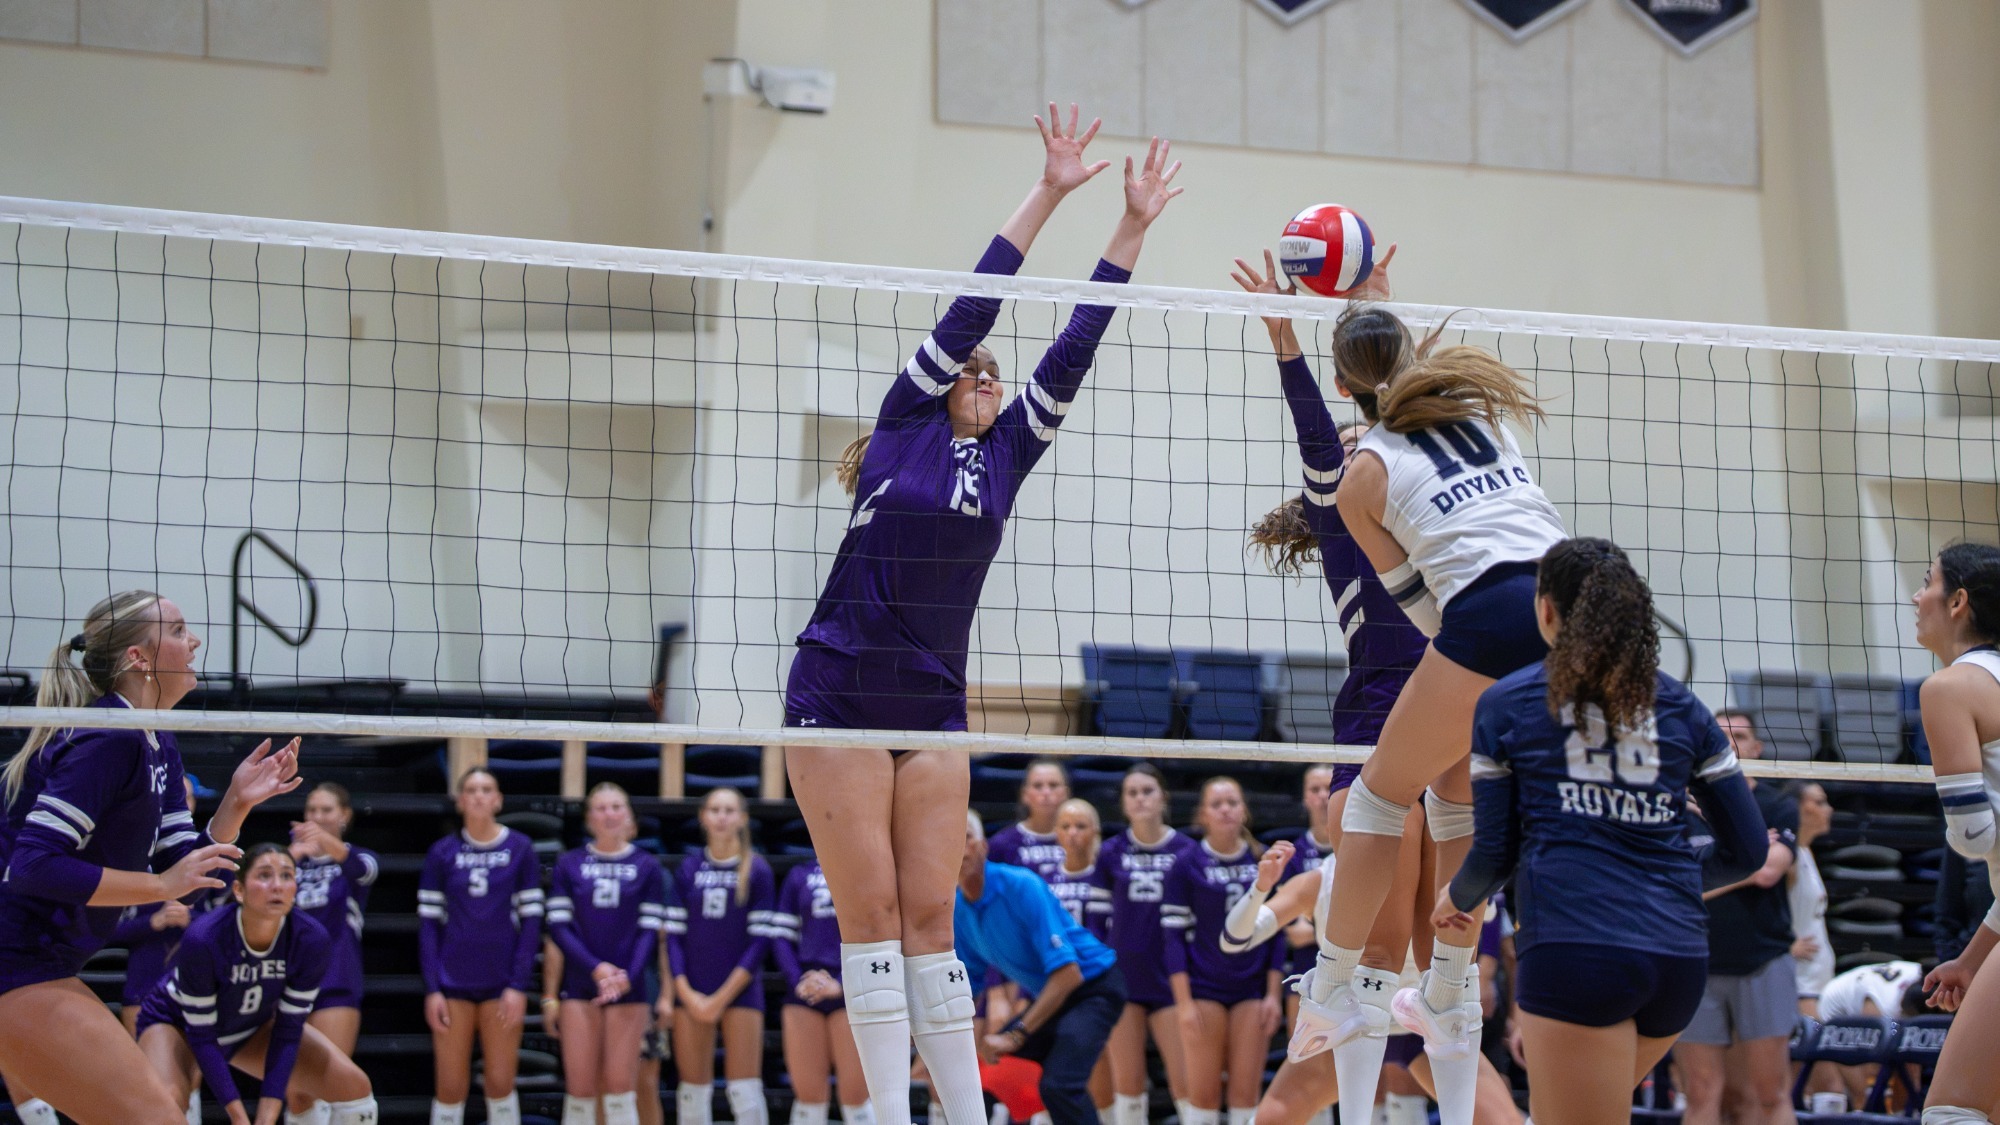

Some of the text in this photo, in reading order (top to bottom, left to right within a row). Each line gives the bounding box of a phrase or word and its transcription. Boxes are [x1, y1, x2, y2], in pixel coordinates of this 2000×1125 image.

[1405, 420, 1499, 482] 10
[1557, 781, 1676, 823] ROYALS
[468, 867, 489, 897] 5
[592, 877, 620, 909] 21
[238, 984, 263, 1015] 8
[1819, 1025, 1880, 1049] ROYALS
